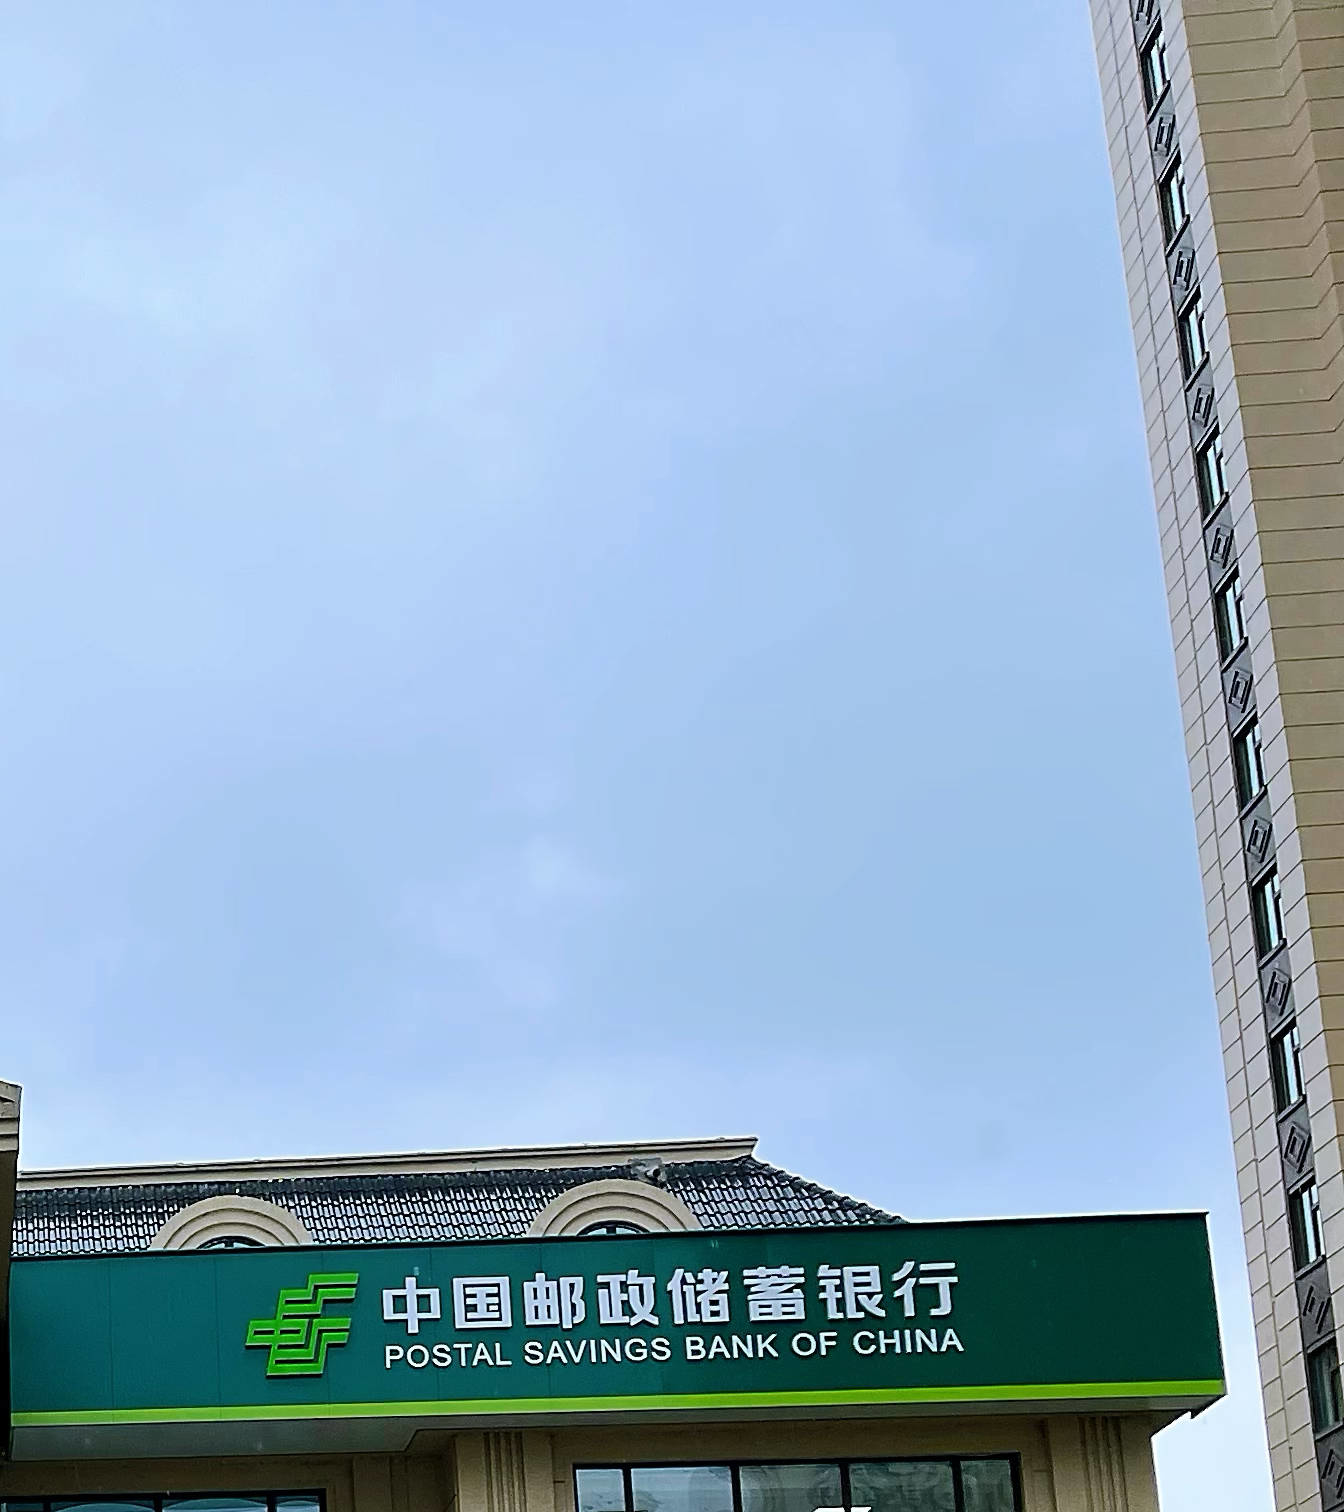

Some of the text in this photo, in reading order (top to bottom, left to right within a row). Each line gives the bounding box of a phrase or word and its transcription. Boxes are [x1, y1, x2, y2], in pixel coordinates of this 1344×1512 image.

[381, 1259, 960, 1335] 中国邮政储蓄银行
[384, 1327, 966, 1370] POSTAL SAVINGS BANK OF CHINA
